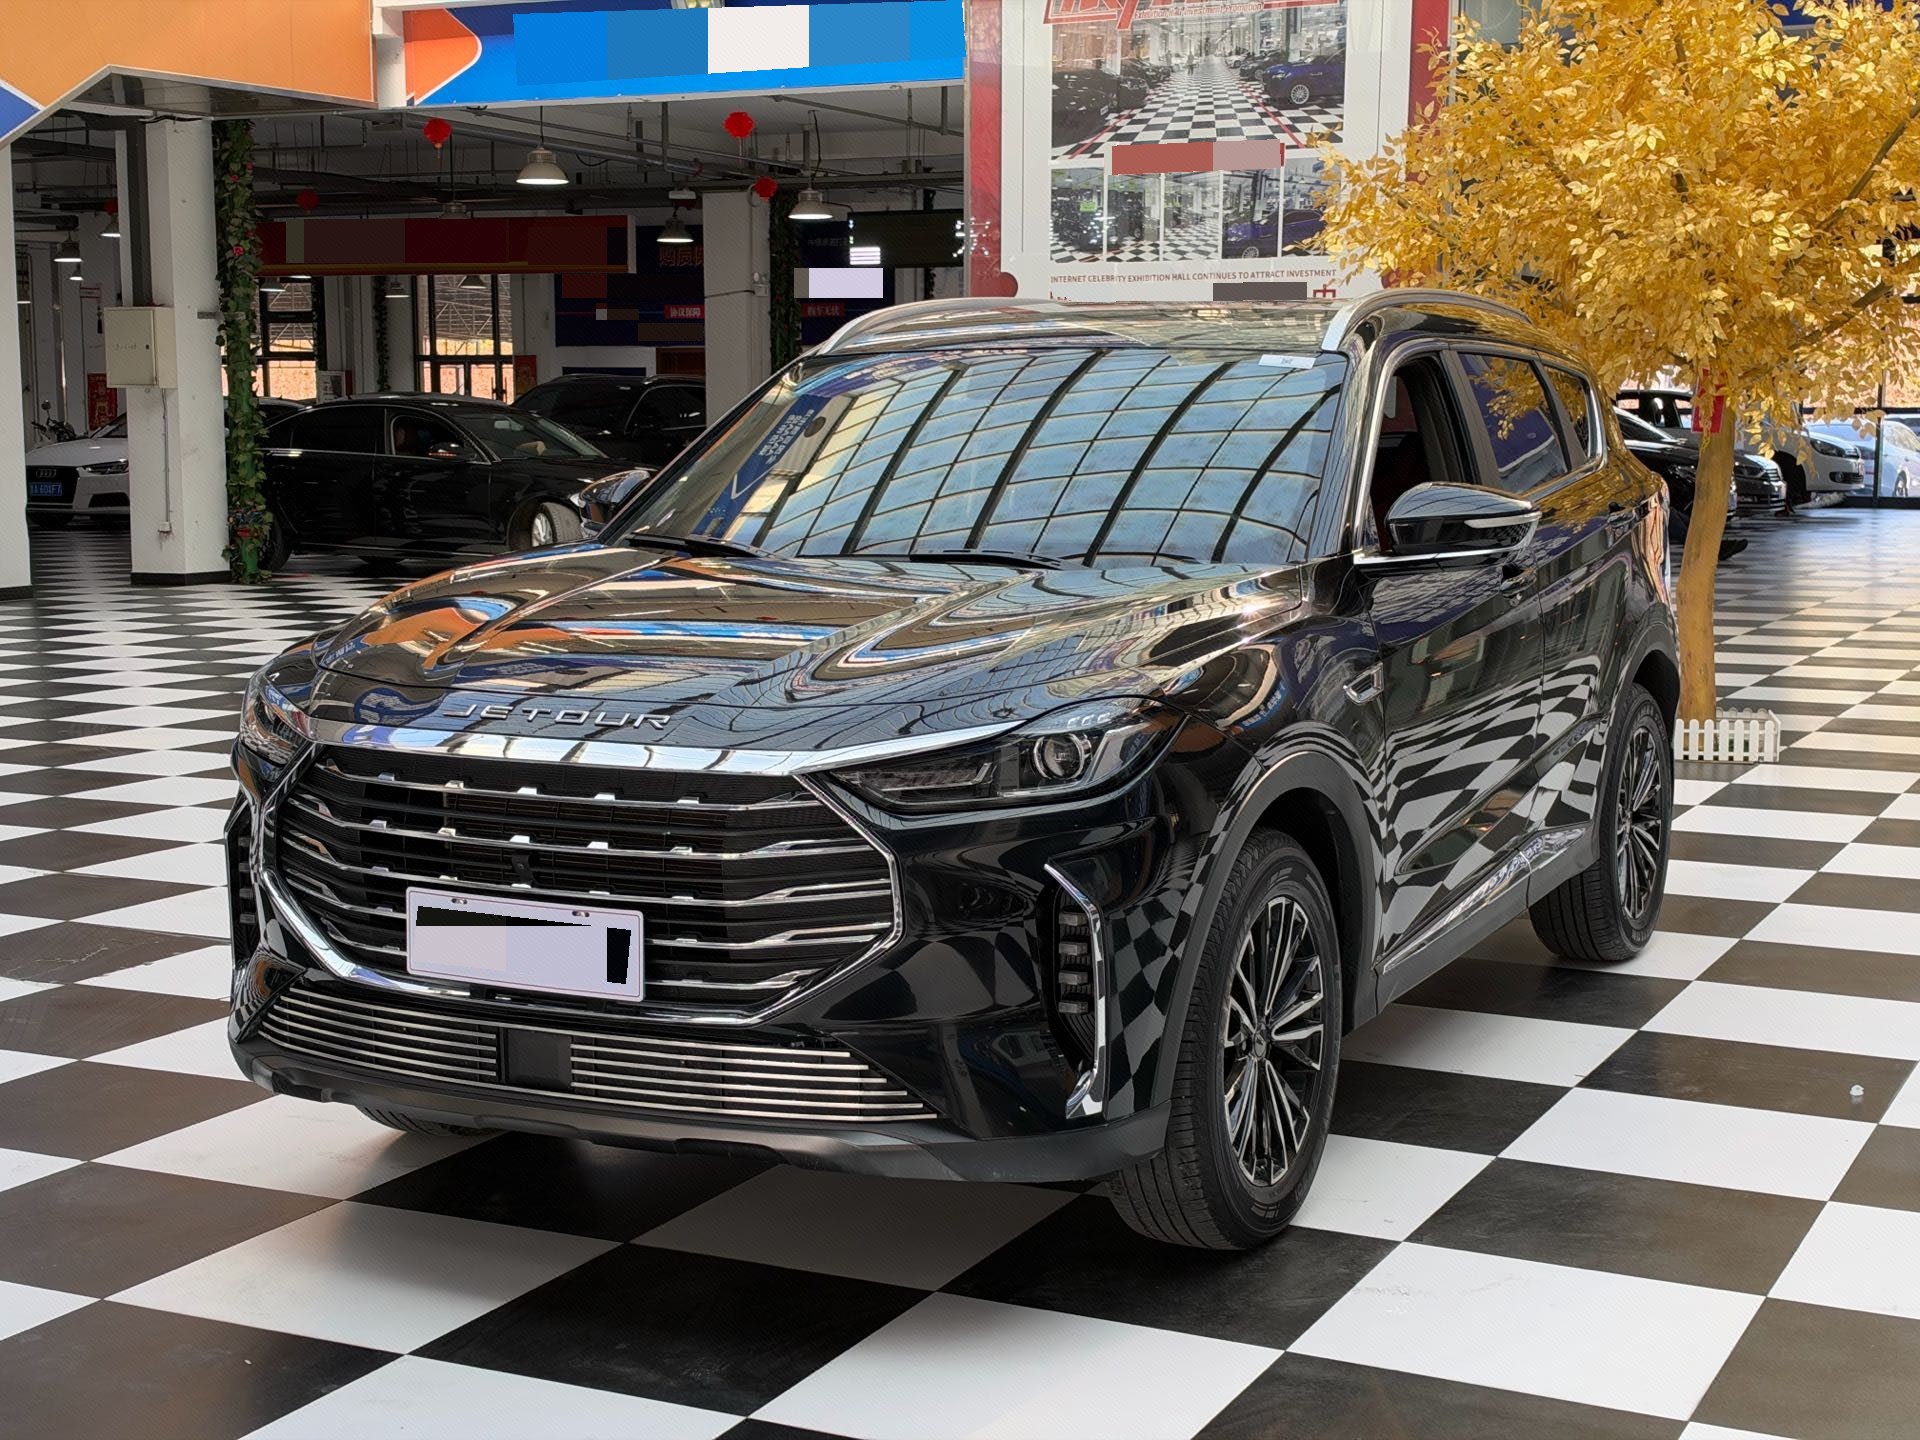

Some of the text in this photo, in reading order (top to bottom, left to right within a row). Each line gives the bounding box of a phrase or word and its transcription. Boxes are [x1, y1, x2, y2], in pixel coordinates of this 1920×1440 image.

[1051, 269, 1337, 284] INTERNET CELEBRITY EXHIBITION HALL CONTINUES TO ATTRACT INVESTMENT
[442, 703, 672, 730] JETOUR
